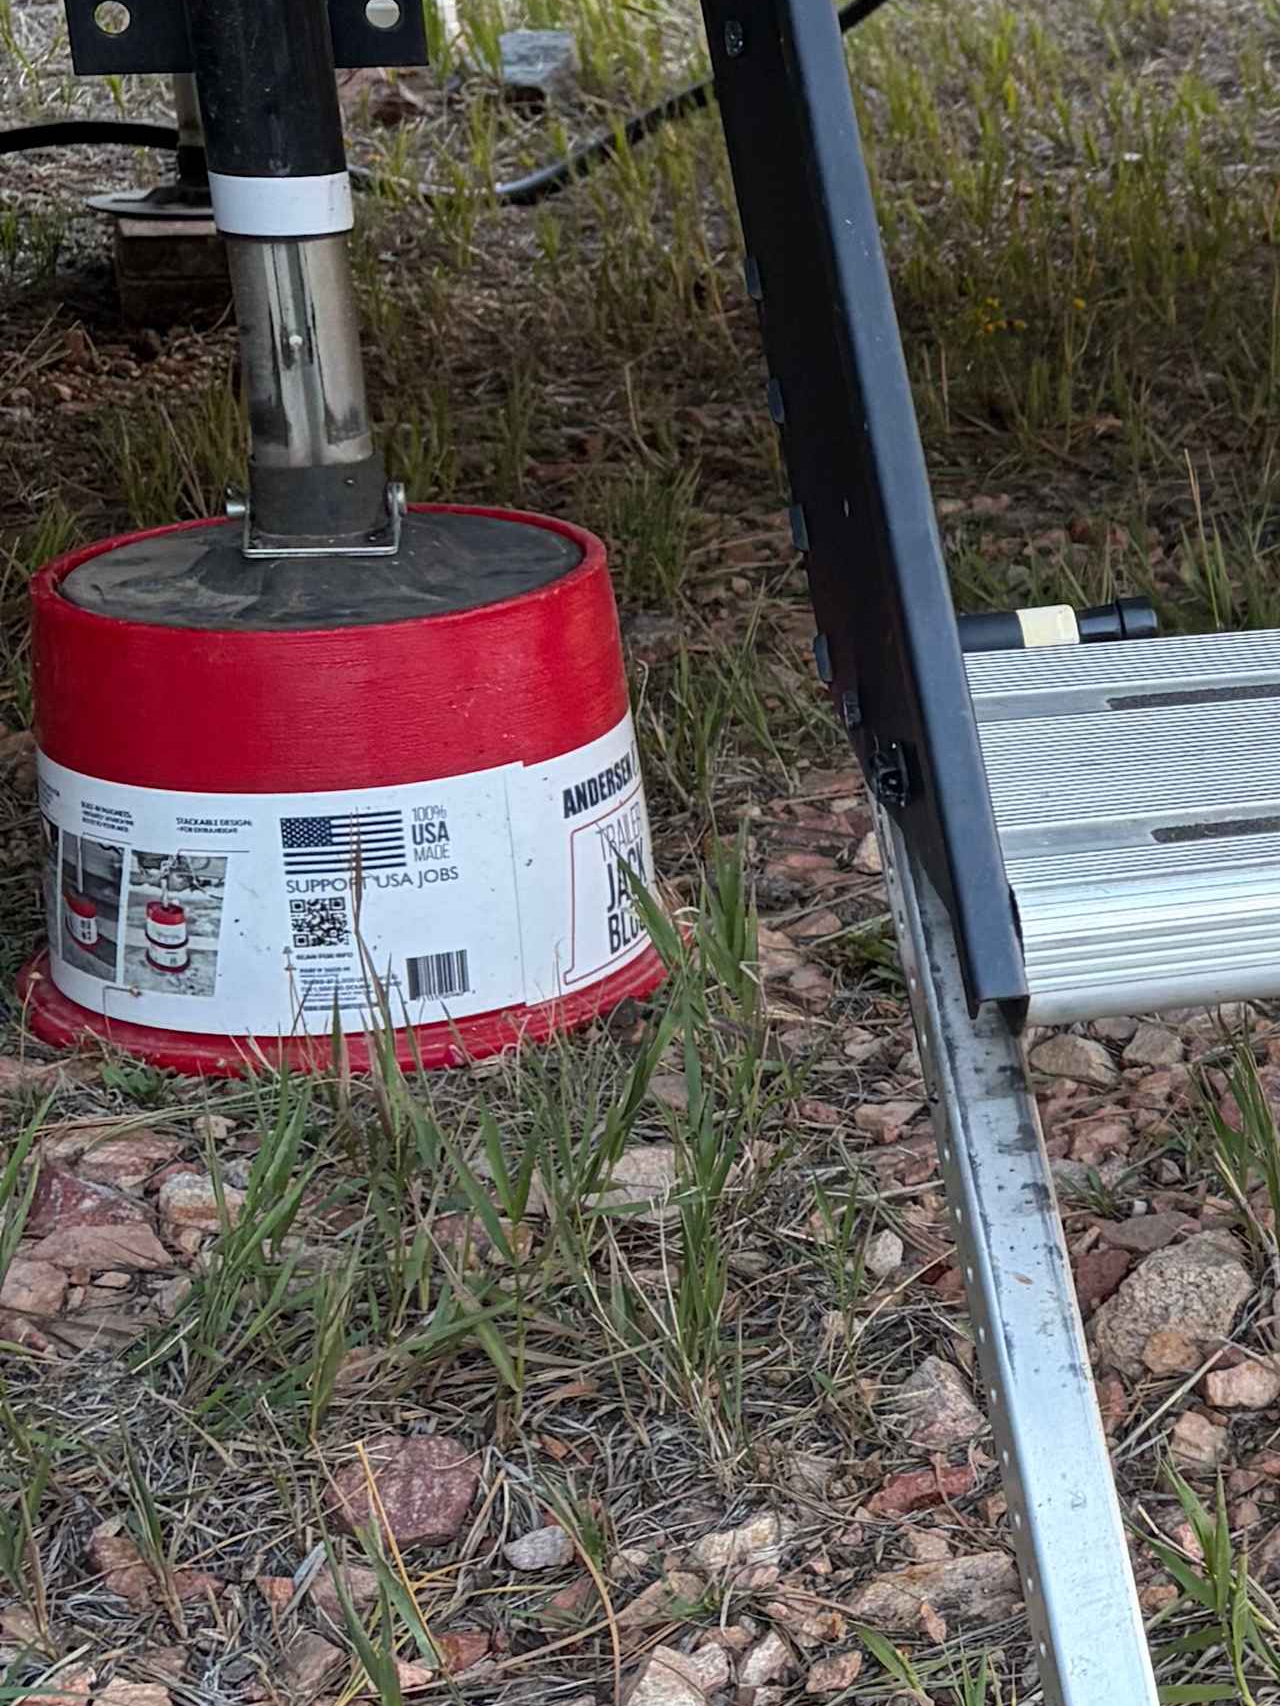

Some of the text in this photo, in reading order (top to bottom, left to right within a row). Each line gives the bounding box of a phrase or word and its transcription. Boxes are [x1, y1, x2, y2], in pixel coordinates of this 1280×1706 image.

[563, 751, 633, 819] ANDERSEN
[411, 805, 448, 822] 100%
[411, 821, 450, 845] USA
[413, 844, 450, 862] MADE
[375, 872, 413, 889] USA
[417, 866, 459, 889] JOBS
[607, 837, 647, 913] JACK
[607, 911, 647, 955] BLO
